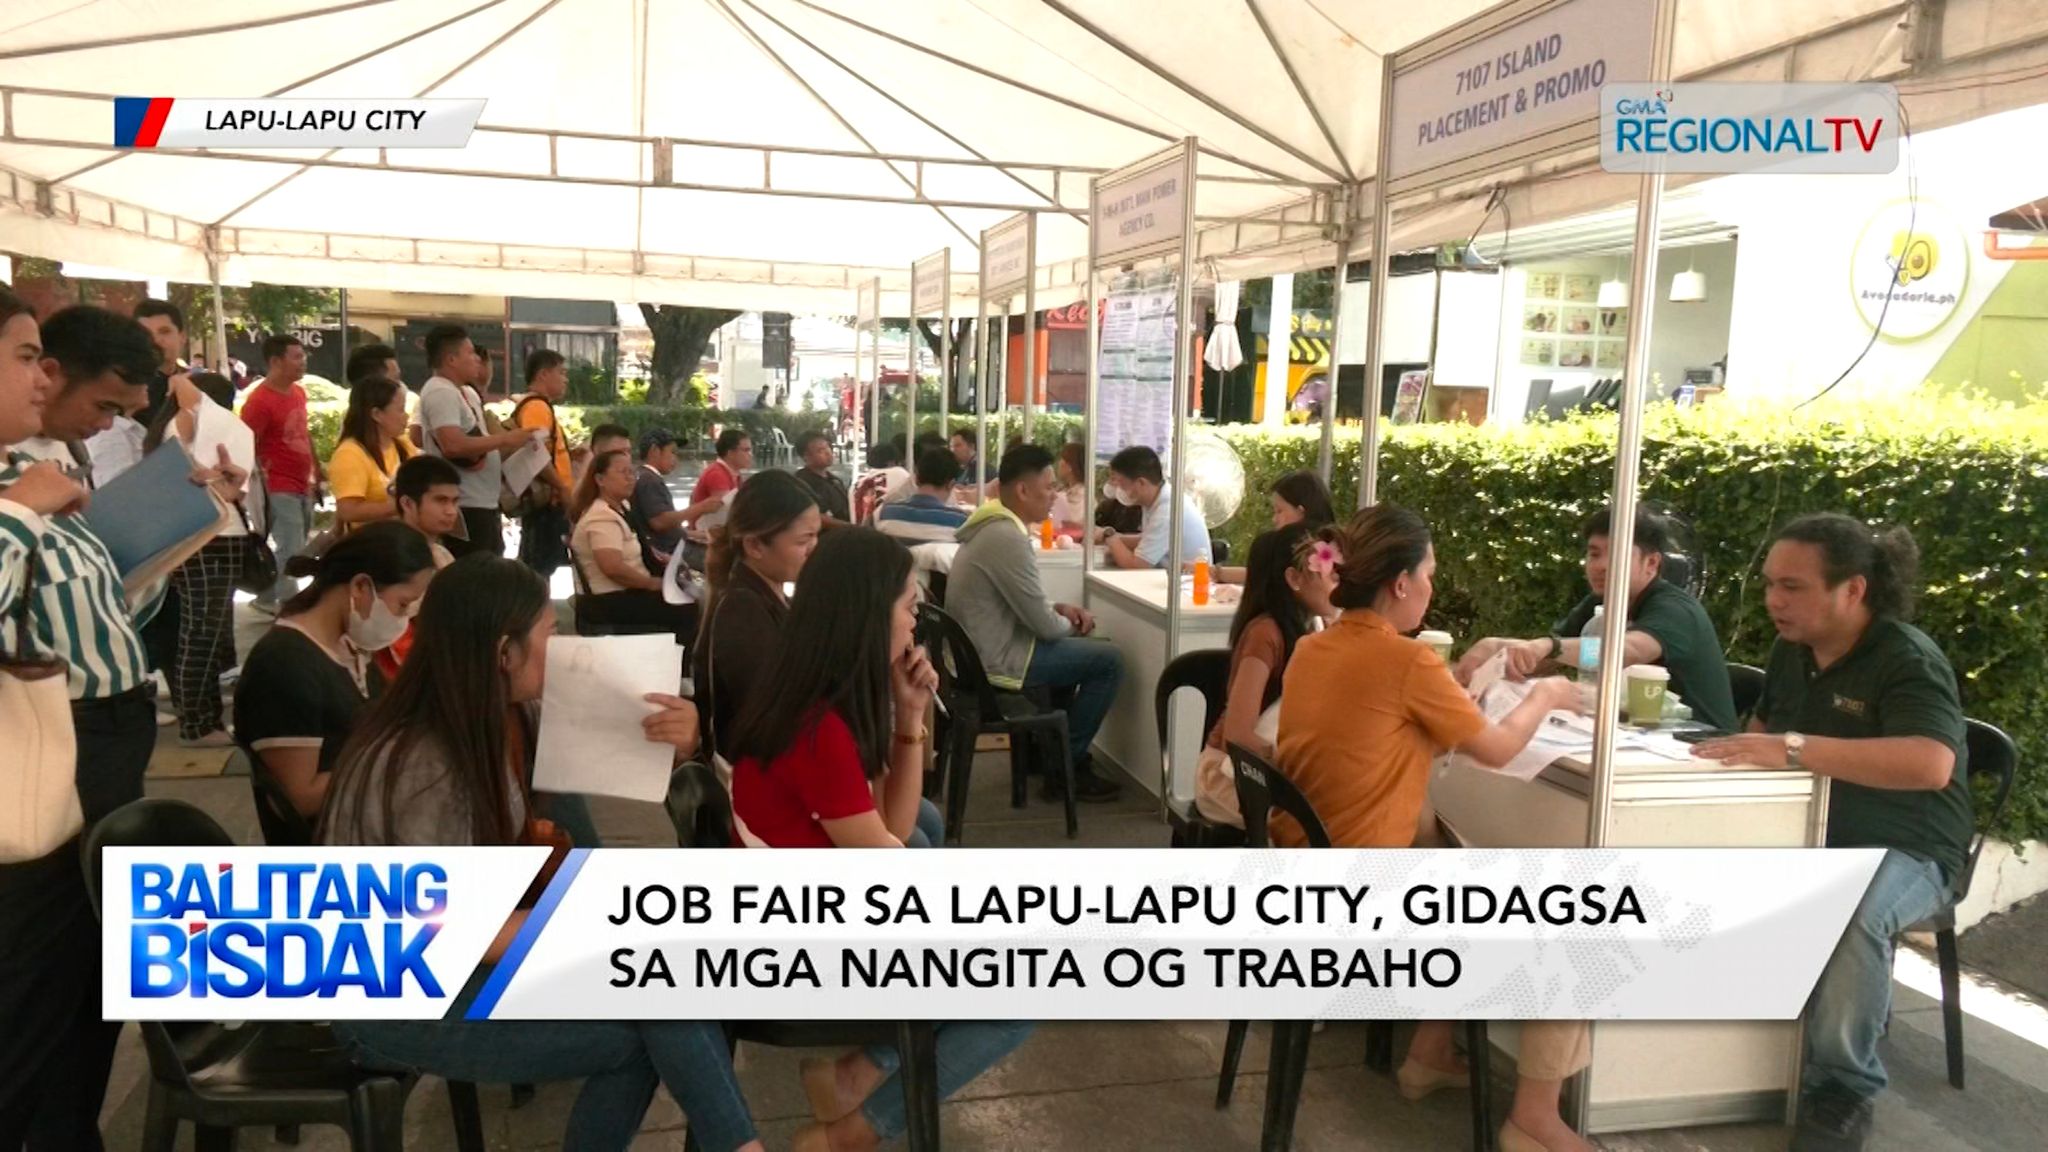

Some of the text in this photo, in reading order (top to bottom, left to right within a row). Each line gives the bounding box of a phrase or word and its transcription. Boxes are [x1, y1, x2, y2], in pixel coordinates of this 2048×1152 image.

[1456, 33, 1562, 95] 7107 ISLAND
[1417, 58, 1606, 146] PLACEMENT & PROMO
